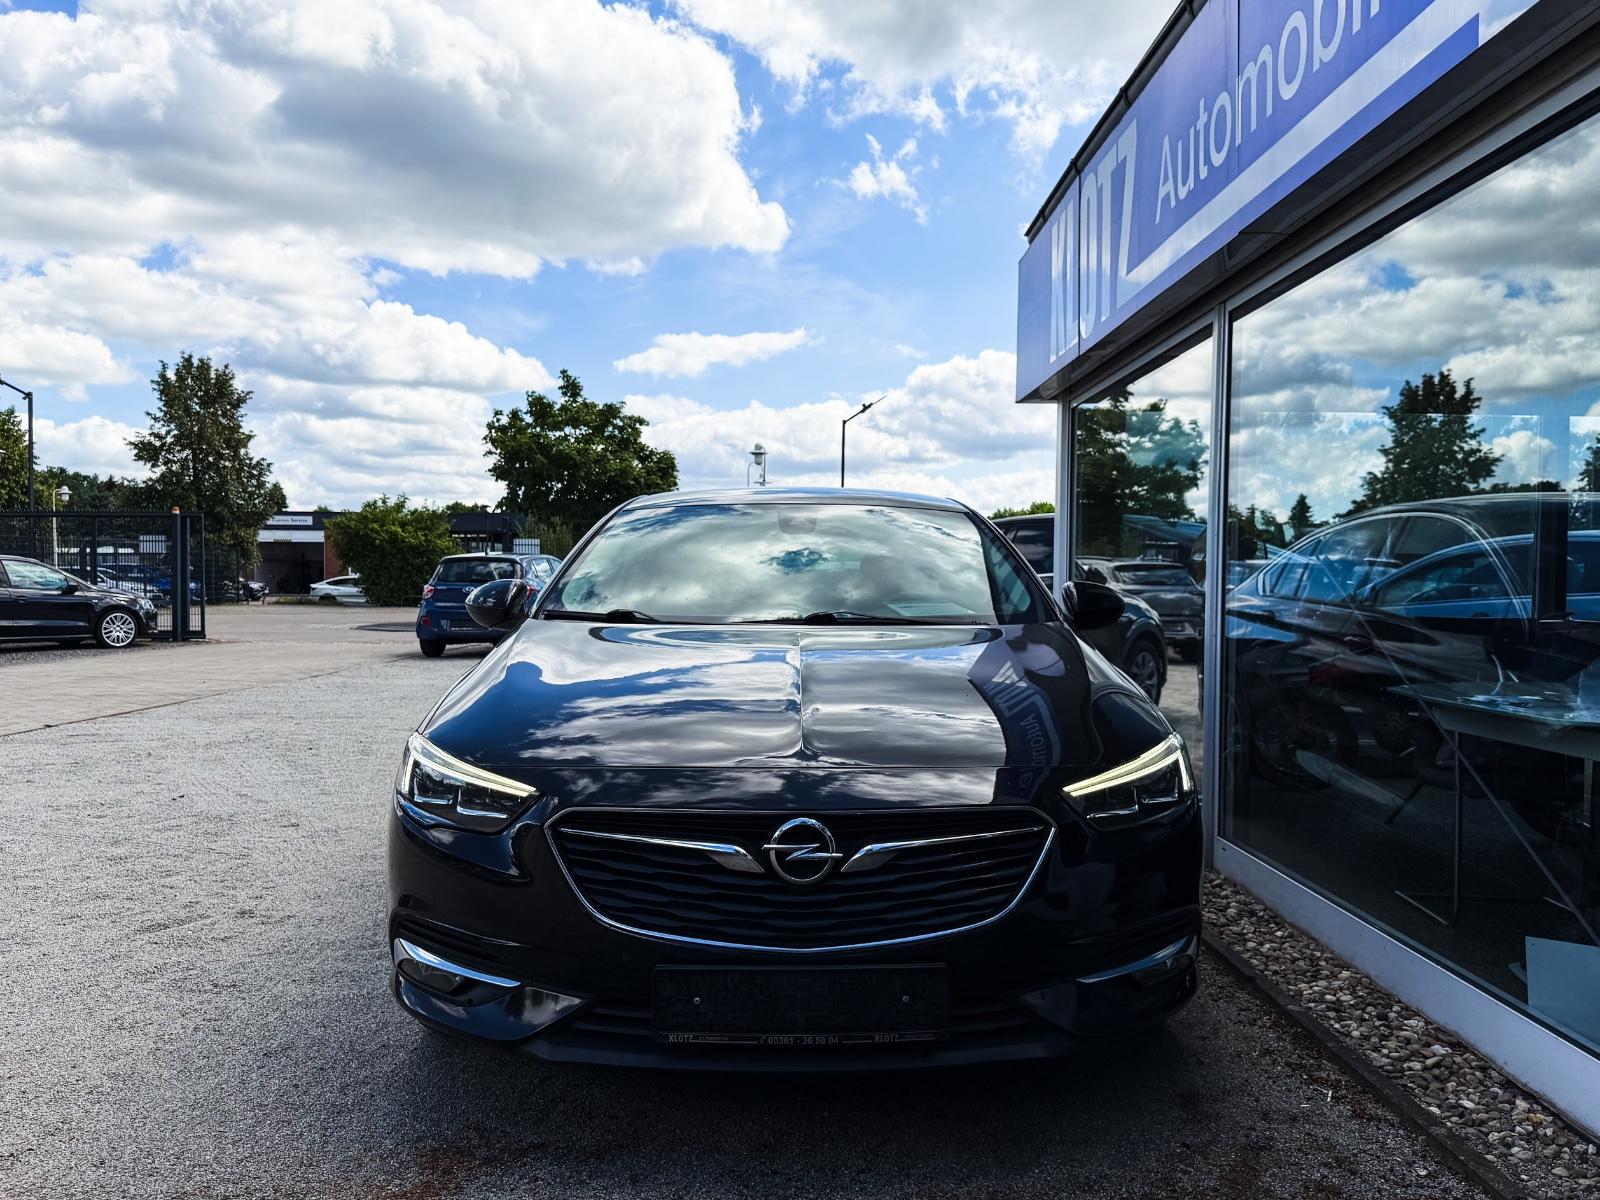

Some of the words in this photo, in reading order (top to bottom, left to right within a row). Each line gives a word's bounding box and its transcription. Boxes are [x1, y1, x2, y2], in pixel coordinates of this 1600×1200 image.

[1049, 118, 1137, 364] KLOTZ
[668, 1033, 694, 1043] KLOTZ
[768, 1036, 794, 1045] 03361
[874, 1033, 899, 1043] KLOTZ
